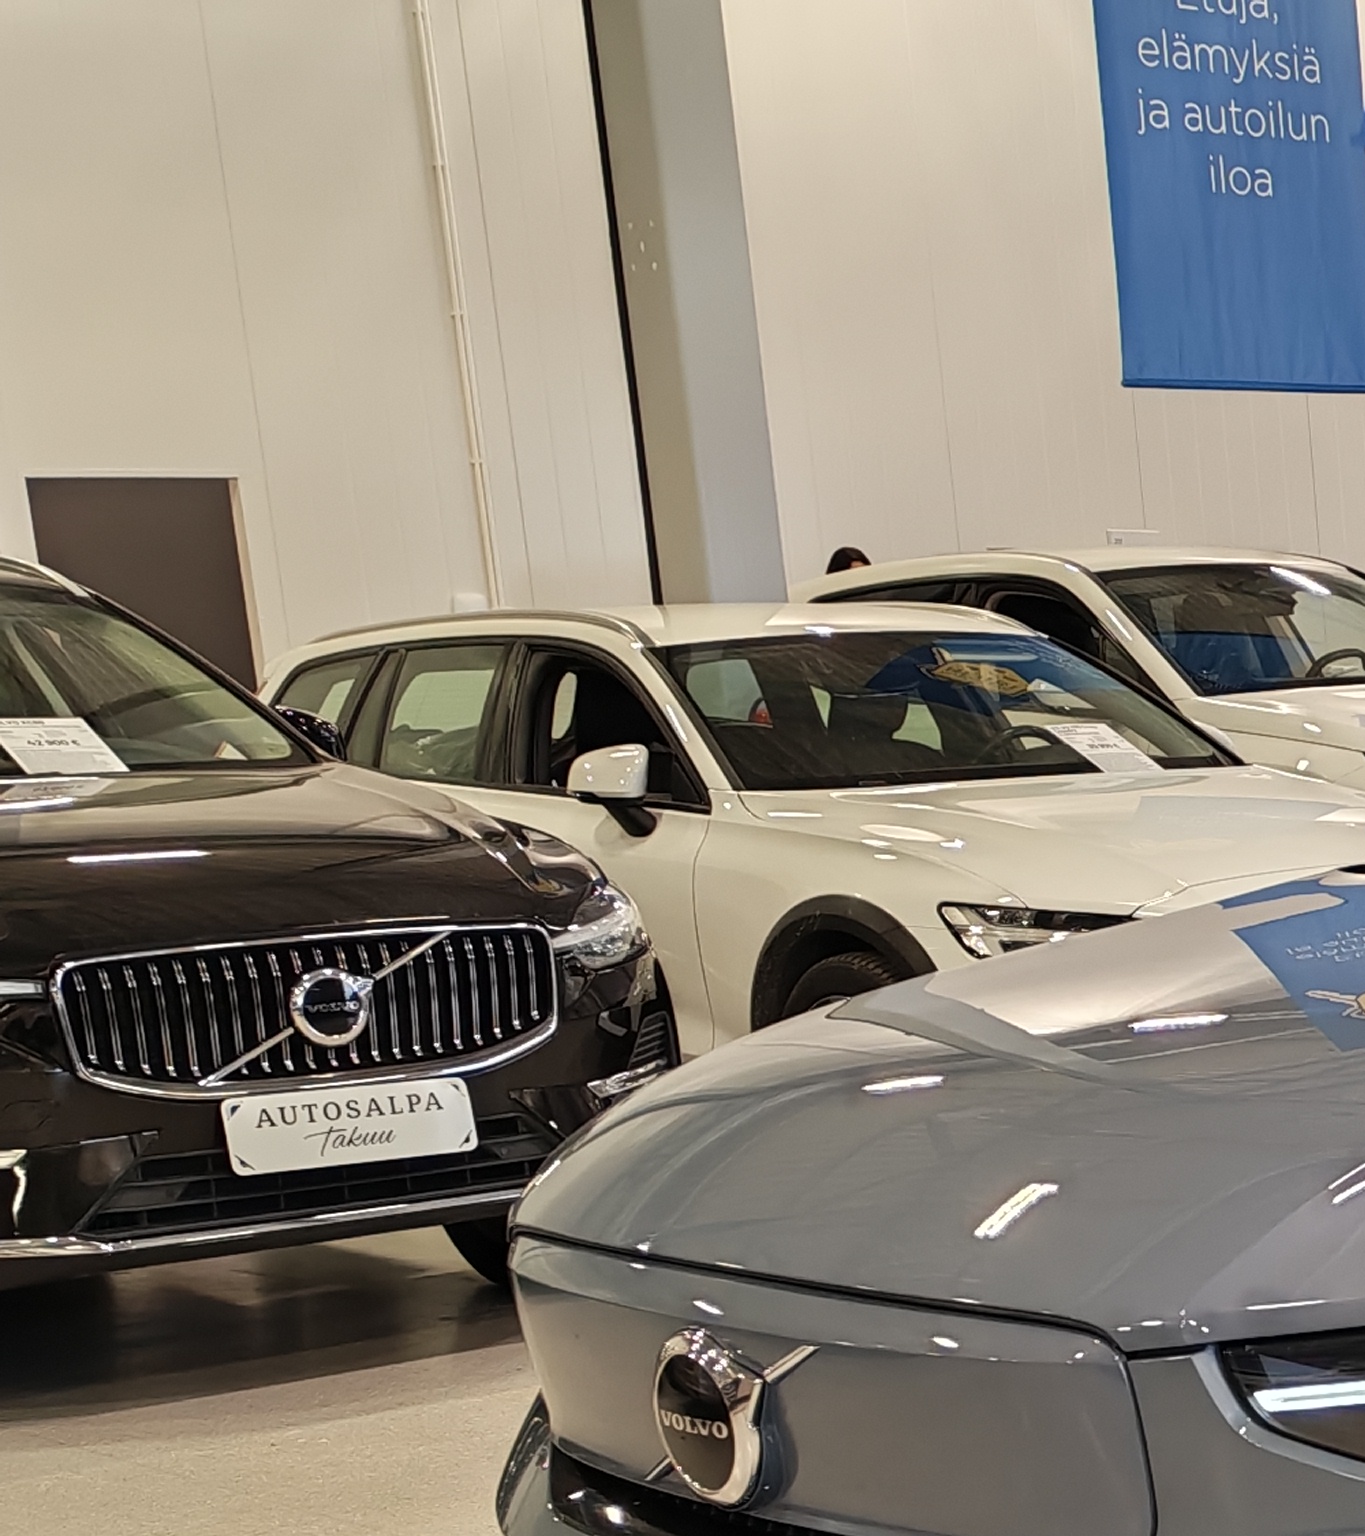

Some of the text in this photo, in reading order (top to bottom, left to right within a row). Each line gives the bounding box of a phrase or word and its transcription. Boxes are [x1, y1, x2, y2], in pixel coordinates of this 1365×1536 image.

[1137, 28, 1322, 84] elämyksiä
[1137, 88, 1330, 143] ja autoilun
[1208, 154, 1273, 198] iloa
[255, 1092, 445, 1128] AUTOSALPA
[304, 1126, 397, 1157] Takuu
[660, 1409, 729, 1439] VOLVO
